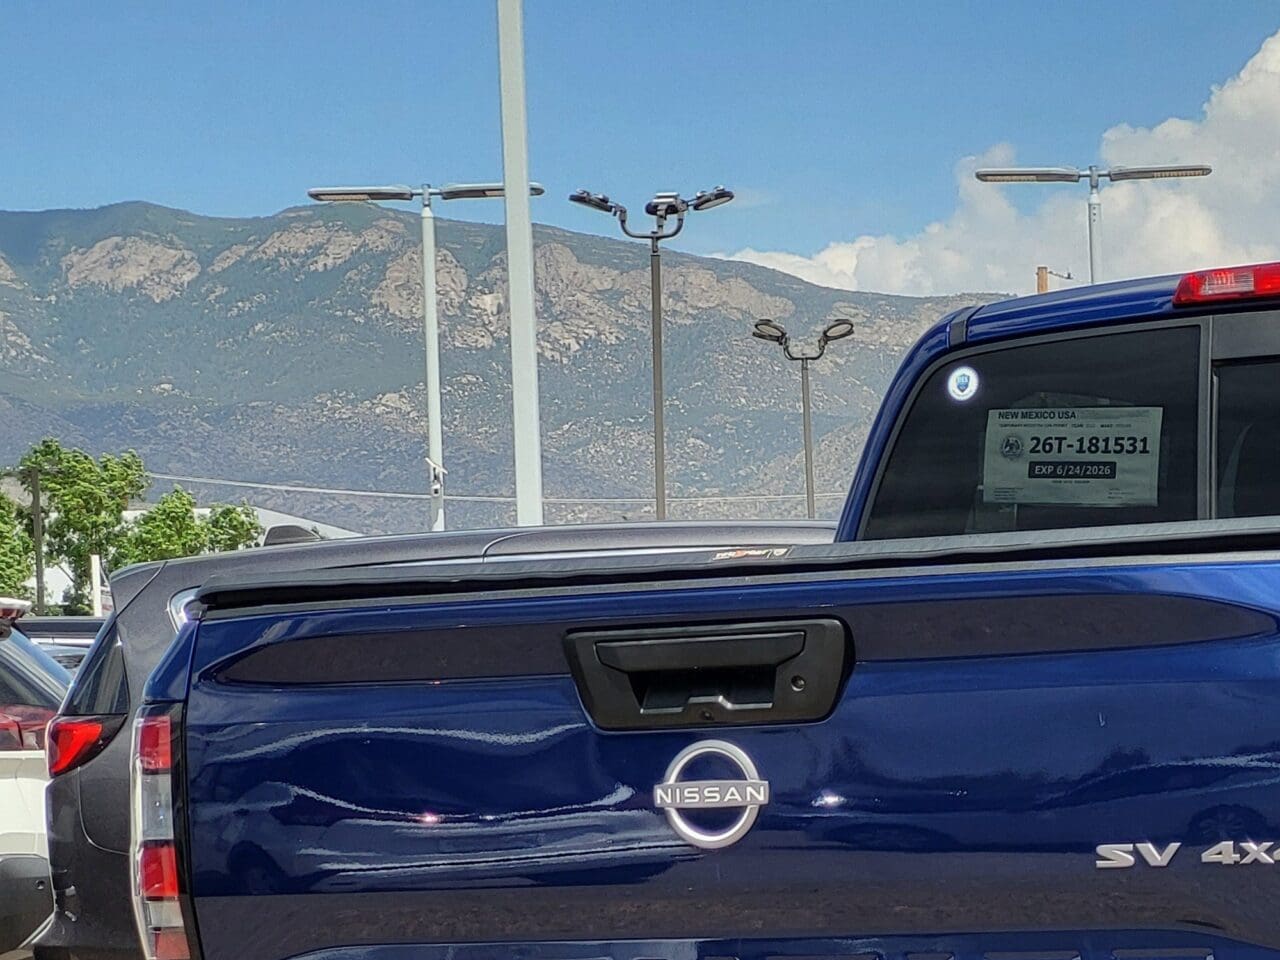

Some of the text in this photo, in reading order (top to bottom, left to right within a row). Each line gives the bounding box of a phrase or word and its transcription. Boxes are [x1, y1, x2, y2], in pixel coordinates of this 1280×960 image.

[998, 410, 1076, 420] NEW MEXICO USA
[1029, 436, 1150, 454] 26T-181531
[1034, 465, 1111, 475] EXP 6/24/2026
[656, 786, 765, 804] NISSAN
[1095, 842, 1181, 868] SV
